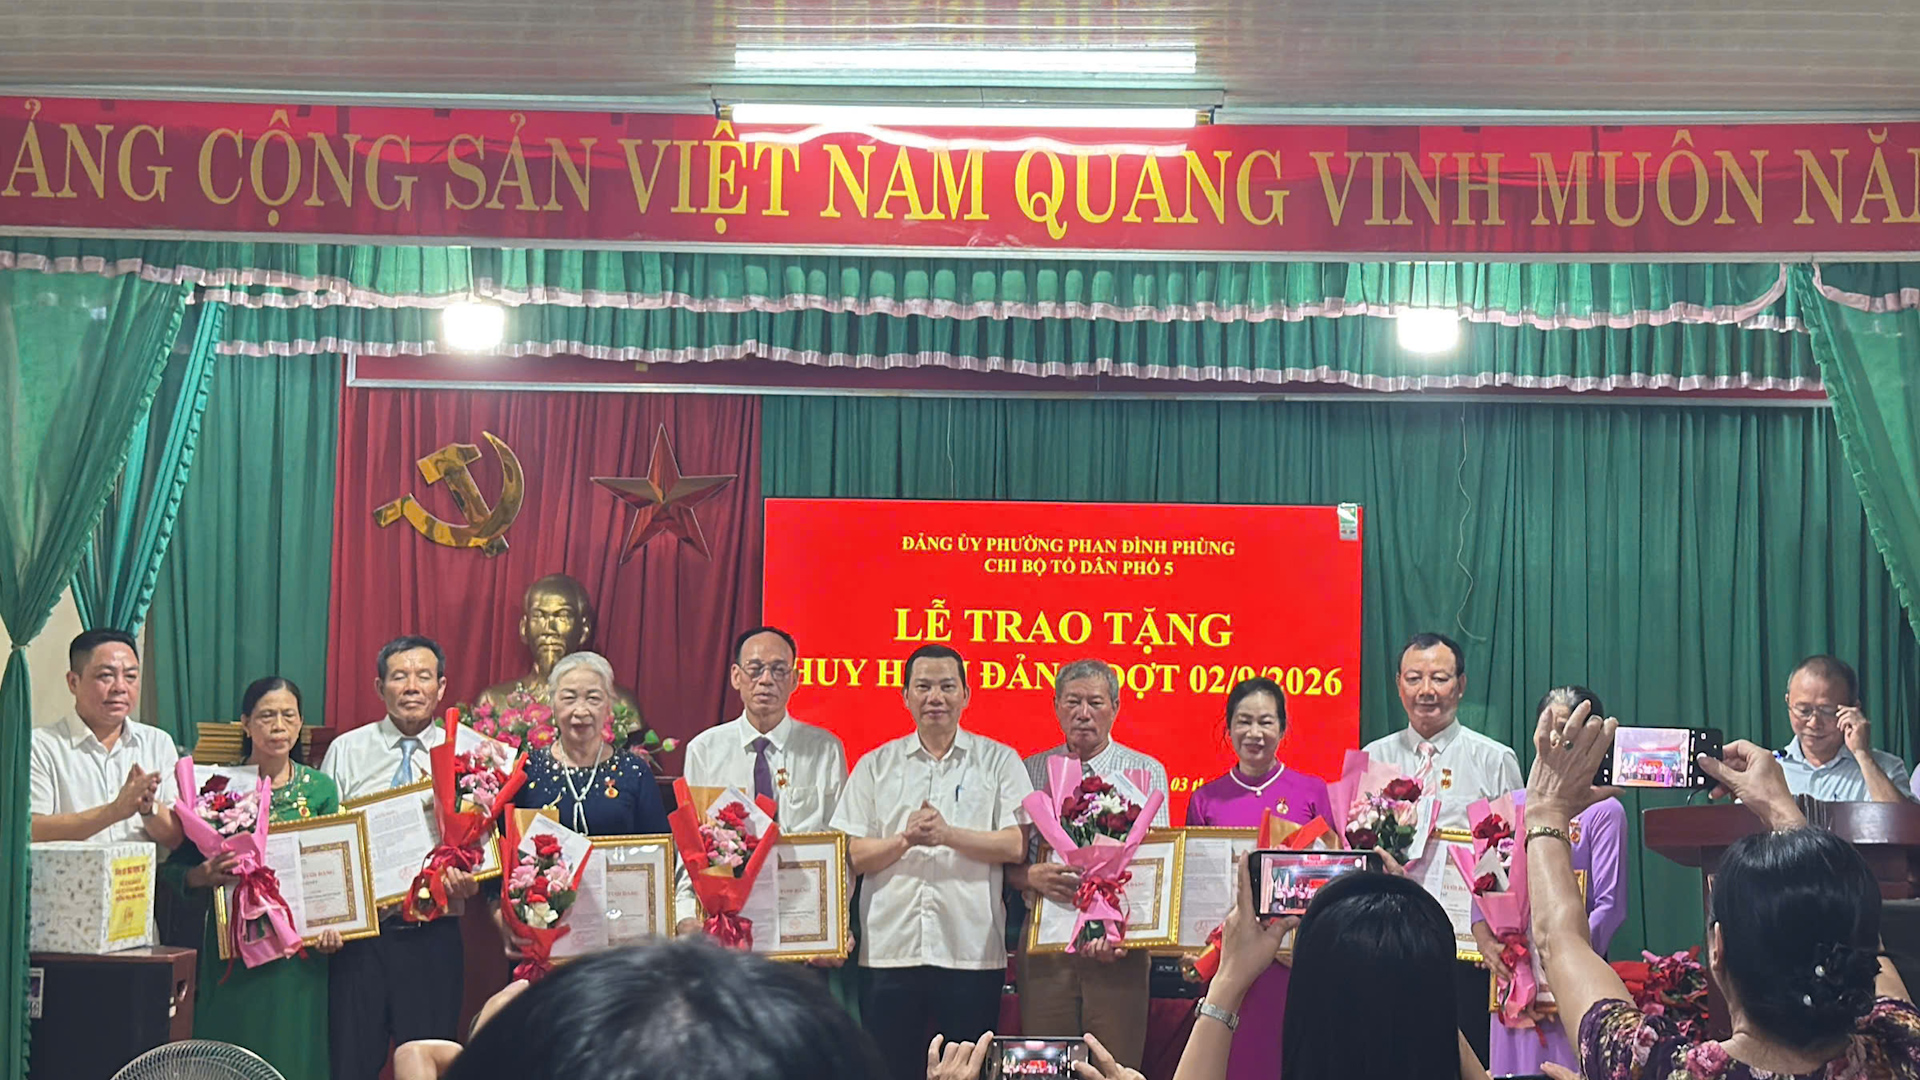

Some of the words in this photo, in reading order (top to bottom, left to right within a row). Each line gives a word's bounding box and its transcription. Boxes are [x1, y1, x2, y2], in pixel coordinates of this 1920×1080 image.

[1, 99, 173, 202] ẢNG
[199, 109, 417, 226] CỘNG
[445, 112, 597, 212] SẢN
[617, 119, 801, 235] VIỆT
[819, 144, 992, 222] NAM
[1013, 148, 1291, 241] QUANG
[1309, 151, 1506, 227] VINH
[1530, 129, 1769, 227] MUÔN
[1793, 126, 1920, 225] NĂ
[902, 532, 953, 552] ĐẢNG
[957, 533, 983, 552] ỦY
[986, 534, 1064, 553] PHƯỜNG
[1068, 538, 1118, 554] PHAN
[1121, 536, 1168, 555] ĐÌNH
[1172, 537, 1236, 556] PHÙNG
[984, 557, 1018, 573] CHI
[1022, 557, 1048, 577] BỘ
[1080, 556, 1118, 575] DÂN
[1122, 557, 1161, 576] PHỐ
[1164, 561, 1175, 576] 5
[893, 598, 953, 643] LỄ
[964, 608, 1093, 645] TRAO
[1103, 607, 1233, 655] TẶNG
[979, 653, 1061, 691] ĐẢN
[1170, 776, 1189, 793] 03
